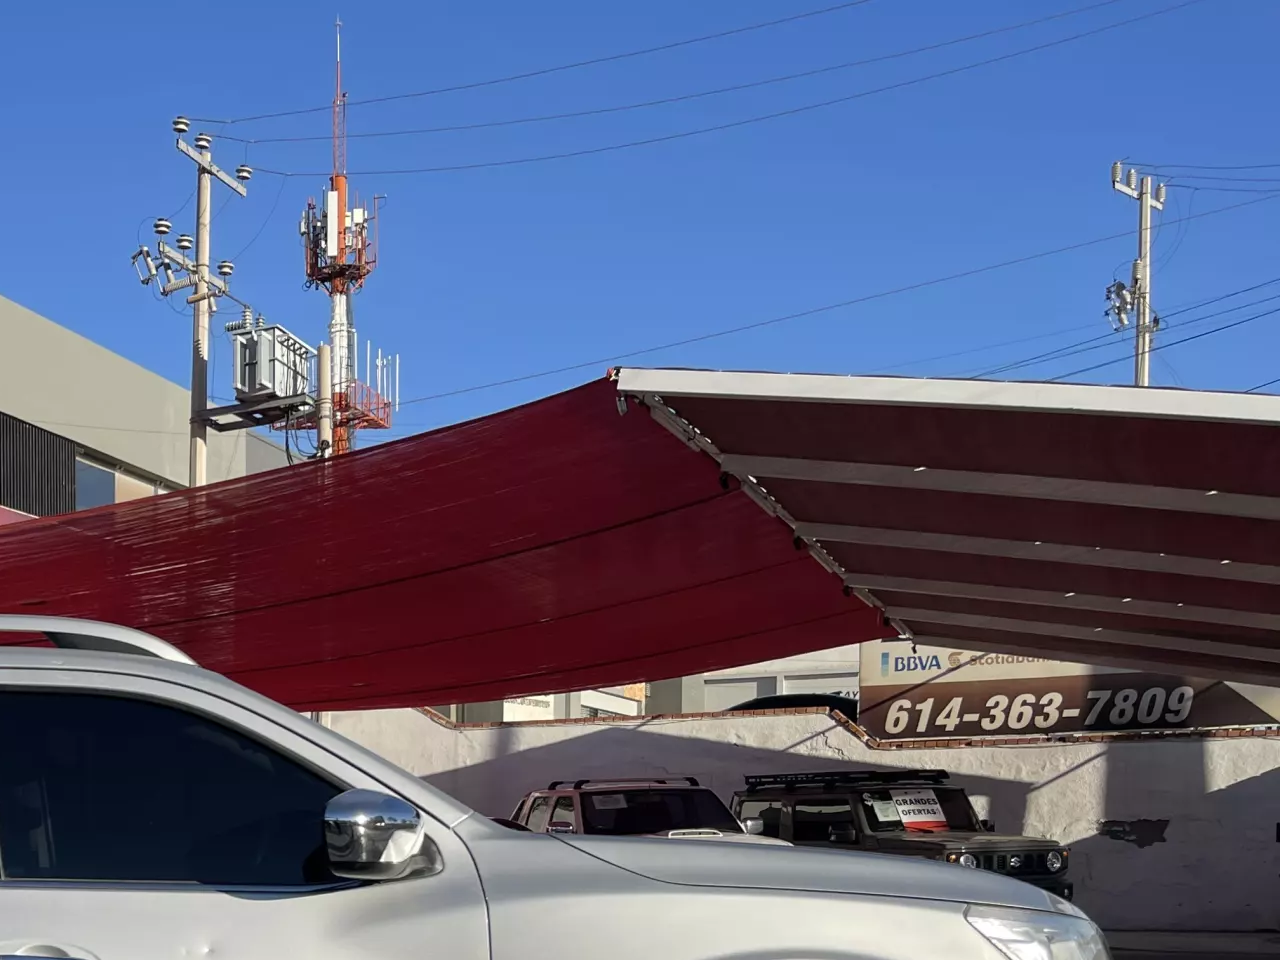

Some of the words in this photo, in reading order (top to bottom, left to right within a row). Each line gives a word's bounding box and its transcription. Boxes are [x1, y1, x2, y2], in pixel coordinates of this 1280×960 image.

[894, 655, 941, 672] BBVA
[885, 686, 1194, 735] 614-363-7809
[895, 798, 938, 807] GRANDES
[901, 808, 937, 817] OFERTAS
